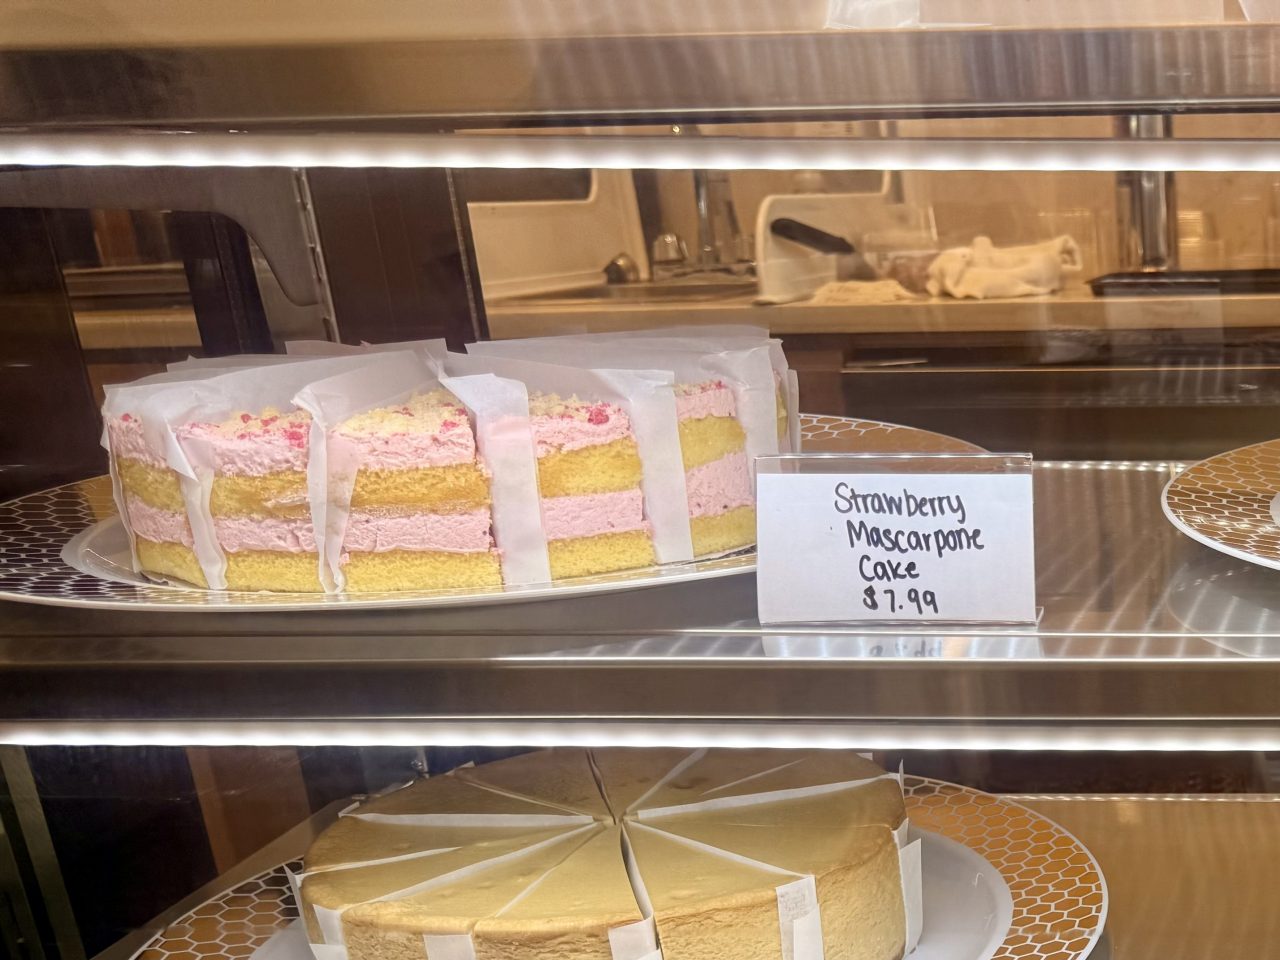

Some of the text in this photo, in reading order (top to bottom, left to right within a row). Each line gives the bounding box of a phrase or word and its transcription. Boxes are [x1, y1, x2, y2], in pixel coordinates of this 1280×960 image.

[834, 481, 966, 523] Strawberry
[846, 519, 985, 558] Mascarpone
[859, 555, 920, 582] Cake
[863, 585, 939, 614] $7.99
